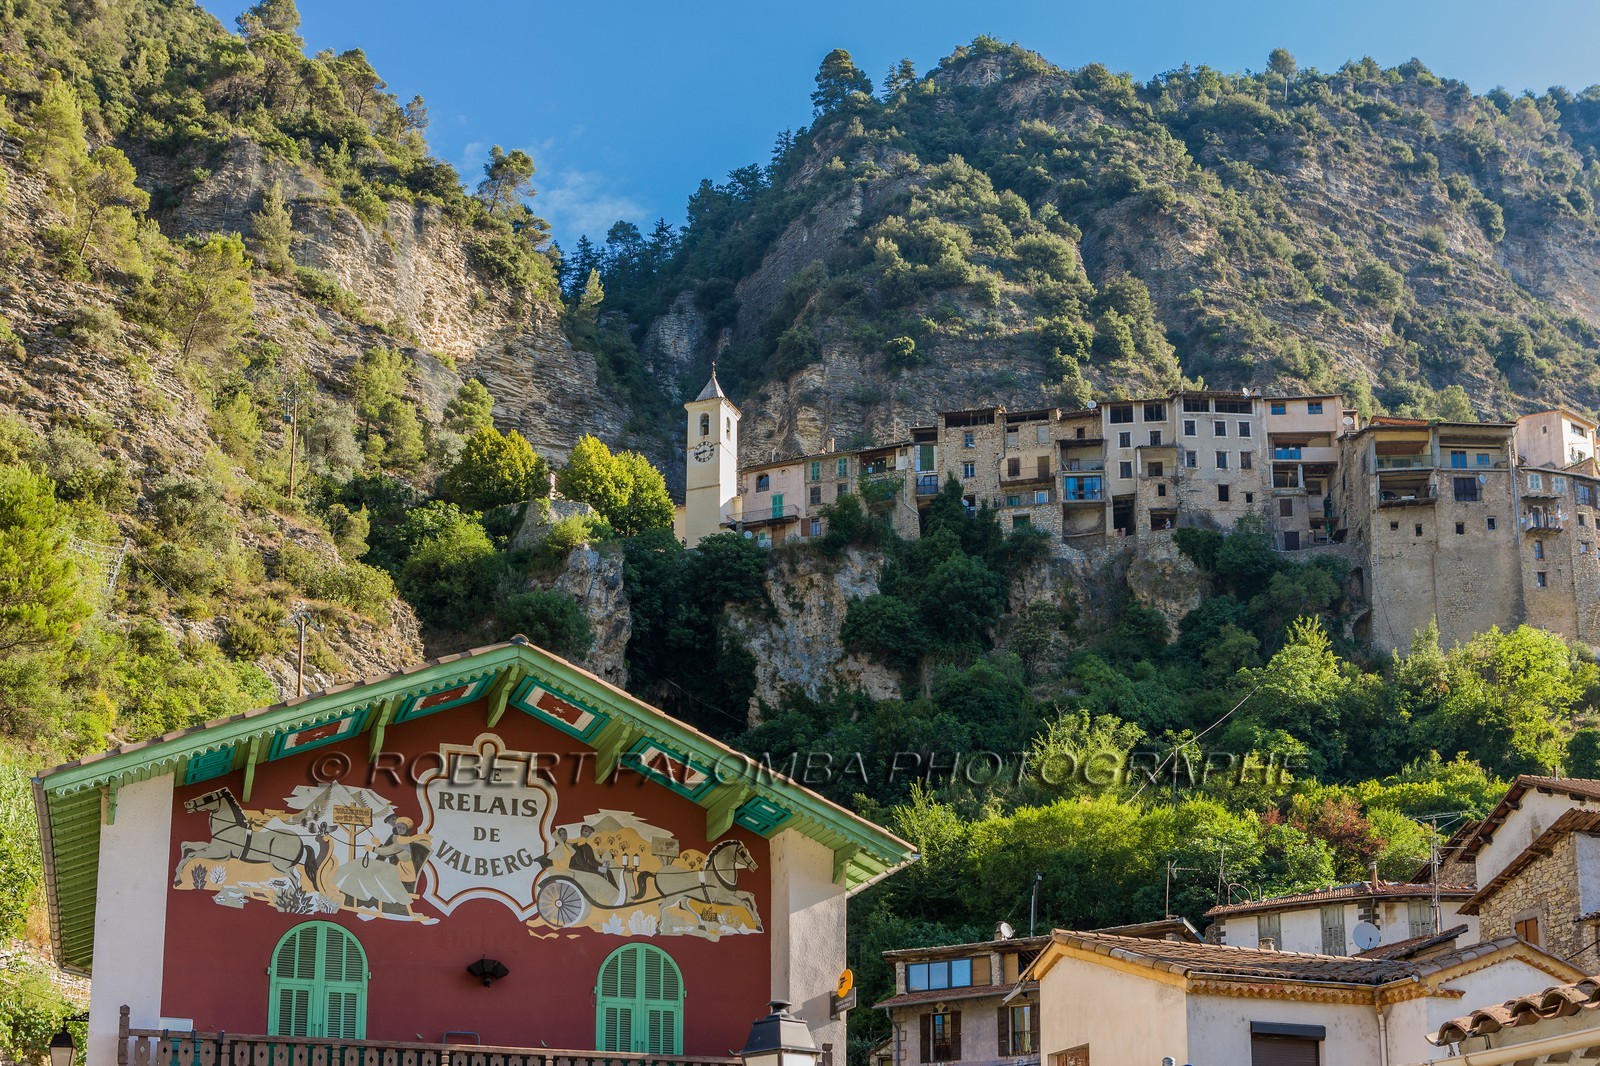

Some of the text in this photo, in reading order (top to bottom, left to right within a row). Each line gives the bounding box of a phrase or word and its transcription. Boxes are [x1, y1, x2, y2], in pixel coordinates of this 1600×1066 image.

[438, 791, 538, 818] RELAIS
[473, 826, 500, 843] DE
[435, 840, 534, 877] VALBERG
